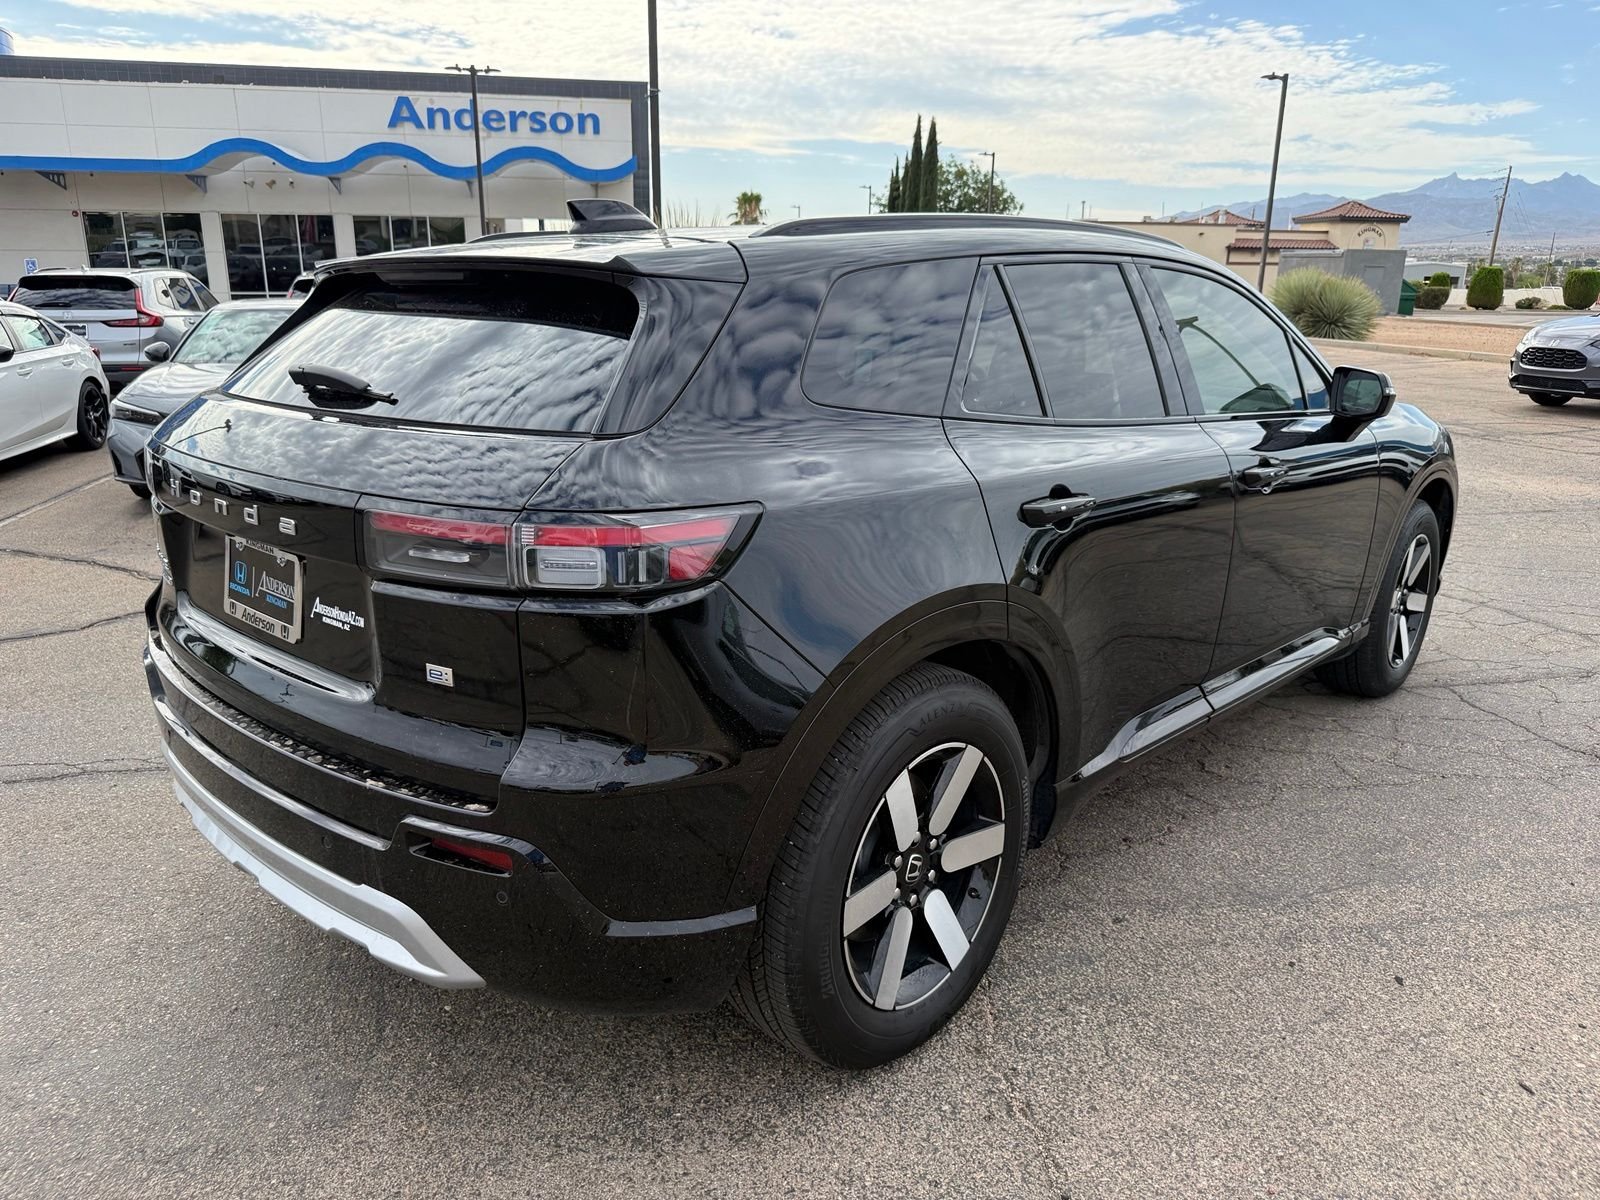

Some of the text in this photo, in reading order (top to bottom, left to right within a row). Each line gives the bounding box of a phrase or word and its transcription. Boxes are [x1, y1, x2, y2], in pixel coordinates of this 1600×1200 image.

[388, 96, 600, 136] Anderson
[170, 478, 297, 536] Honda
[246, 539, 275, 555] KINGMAN
[229, 582, 251, 596] HONDA
[255, 570, 296, 601] ANDERSON
[265, 593, 288, 609] KINGMAN
[241, 607, 275, 634] Anderson
